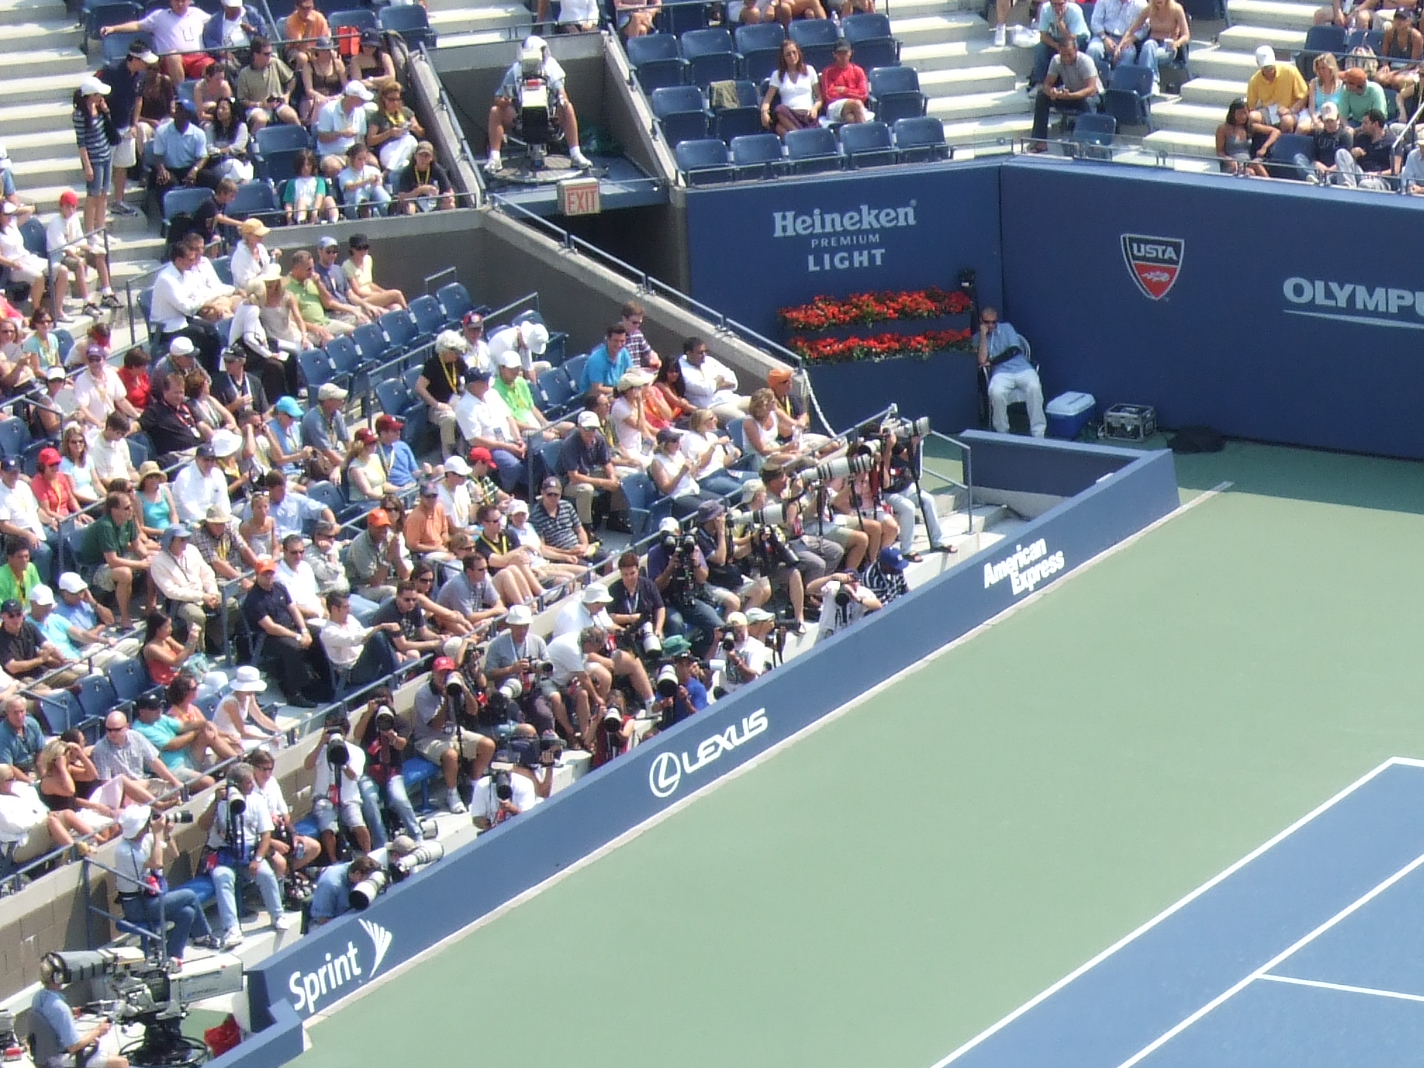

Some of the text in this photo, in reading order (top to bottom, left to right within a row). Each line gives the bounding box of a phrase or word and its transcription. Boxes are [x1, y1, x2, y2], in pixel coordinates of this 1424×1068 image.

[566, 189, 597, 212] EXIT
[773, 202, 916, 238] Heineken
[811, 233, 880, 248] PREMIUM
[1132, 243, 1178, 261] USTA
[808, 248, 886, 272] LIGHT
[983, 538, 1048, 589] American
[1010, 550, 1065, 596] Express
[682, 707, 769, 774] LEXUS
[288, 940, 362, 1014] Sprint
